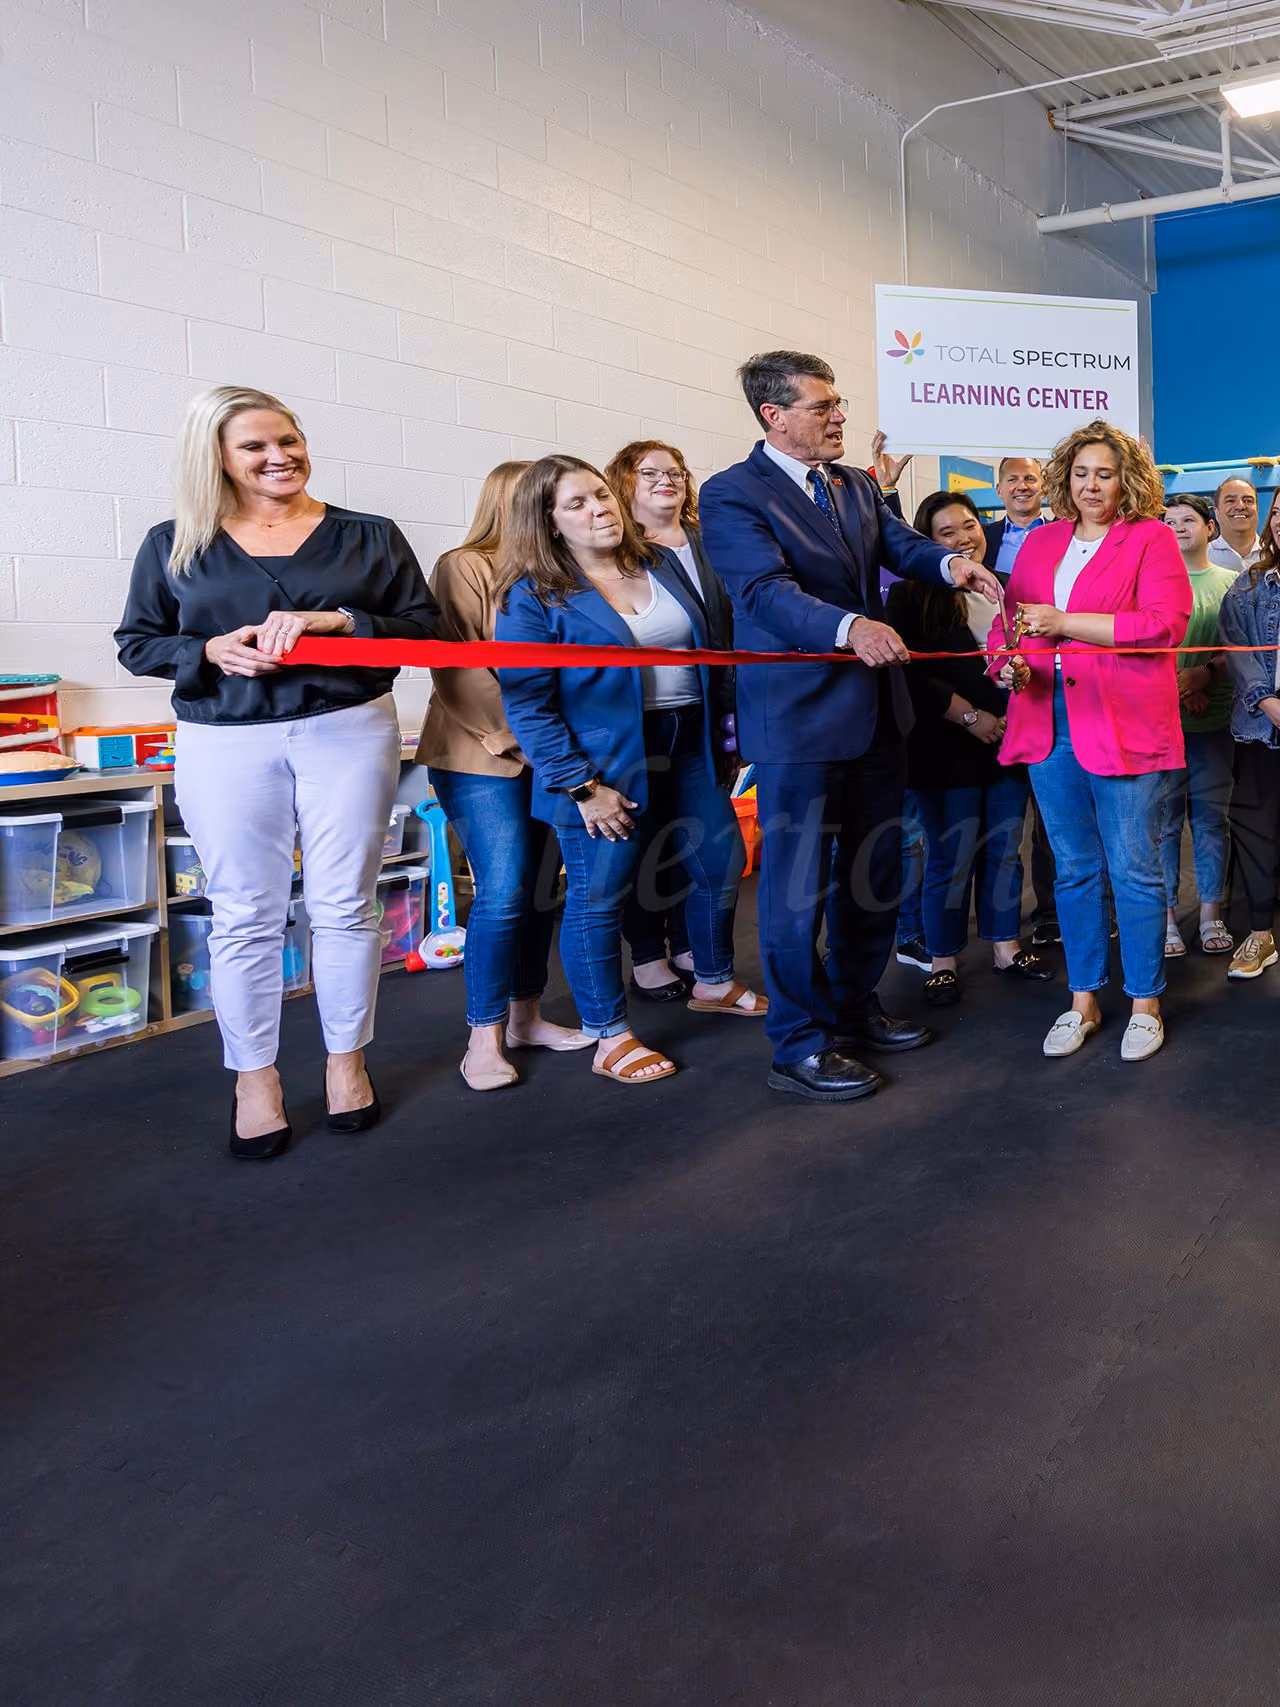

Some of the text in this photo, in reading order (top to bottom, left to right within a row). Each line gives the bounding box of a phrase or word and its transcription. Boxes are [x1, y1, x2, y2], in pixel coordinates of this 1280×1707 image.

[935, 345, 1131, 371] TOTAL SPECTRUM
[910, 382, 1109, 411] LEARNING CENTER
